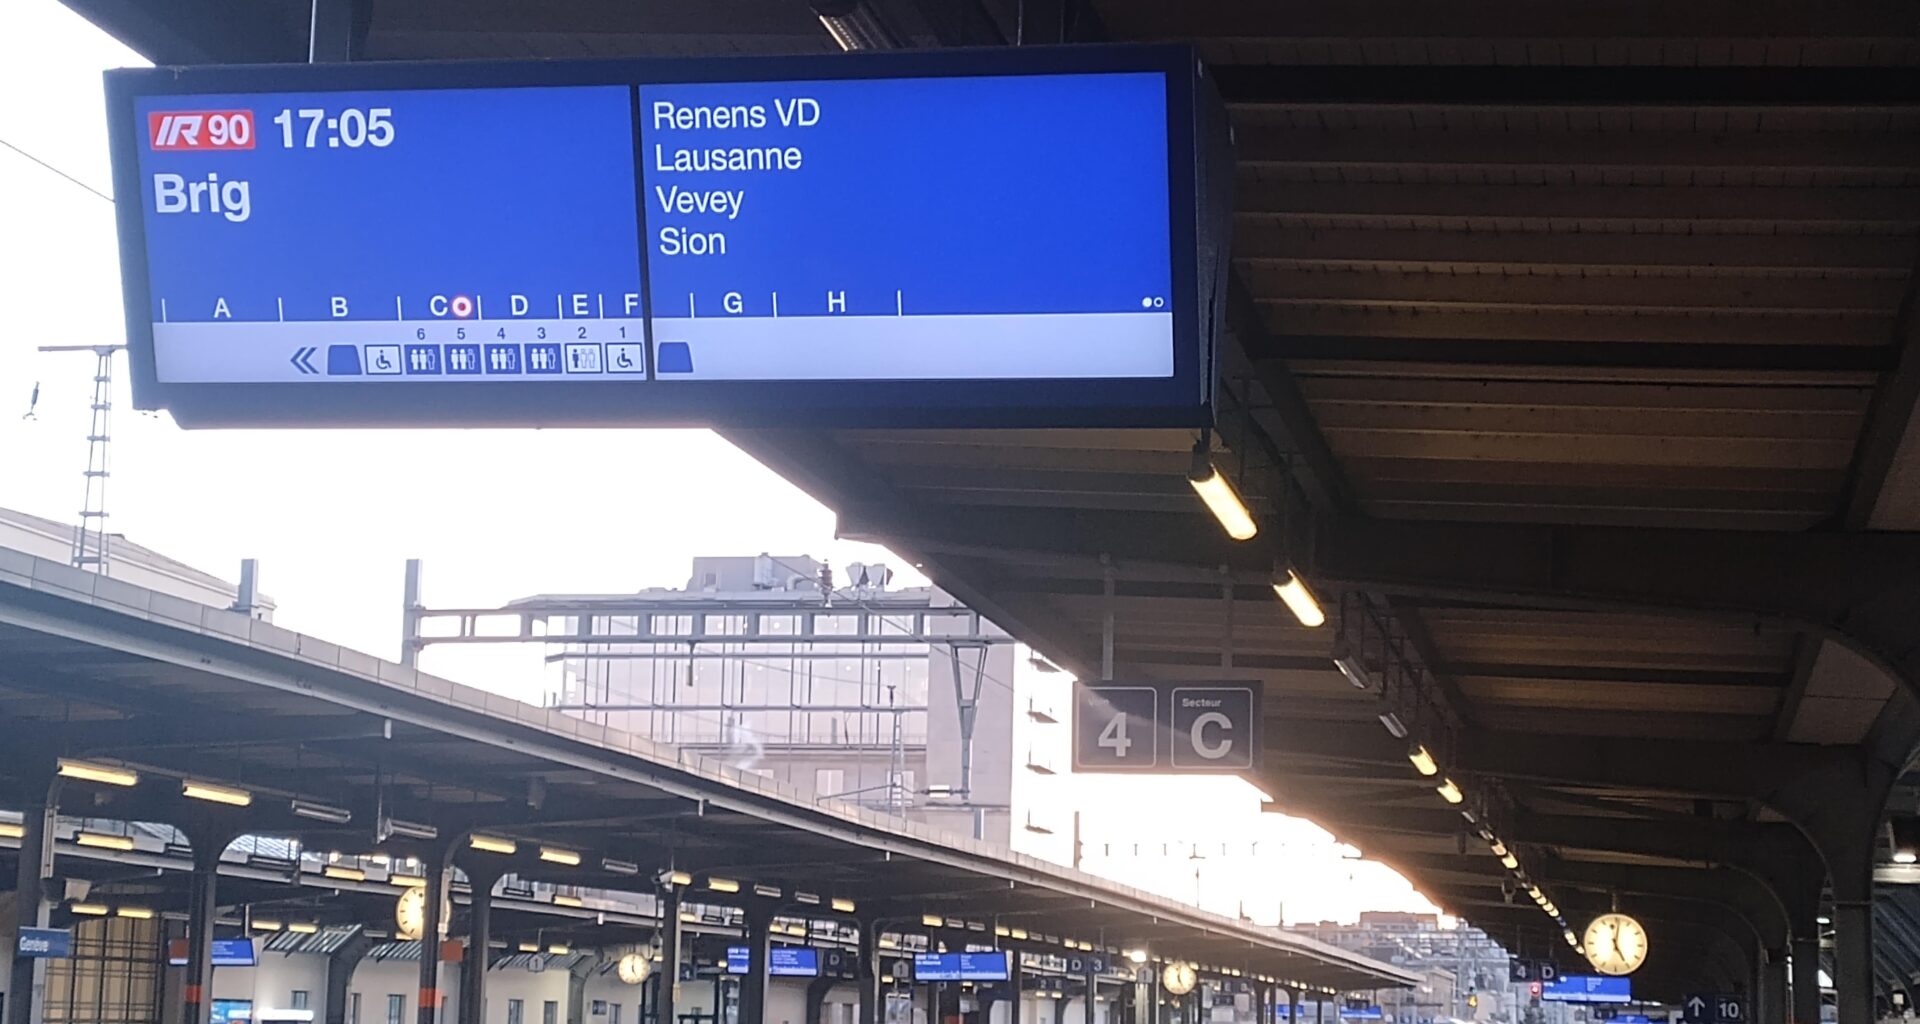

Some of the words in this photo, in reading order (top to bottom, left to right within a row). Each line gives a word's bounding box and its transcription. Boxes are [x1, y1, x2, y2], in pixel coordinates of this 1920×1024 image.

[653, 101, 766, 129] Renens
[775, 98, 820, 126] VD
[156, 116, 202, 146] IR
[208, 114, 250, 146] 90
[273, 108, 395, 148] 17:05
[655, 143, 802, 171] Lausanne
[153, 173, 251, 222] Brig
[656, 185, 744, 219] Vevey
[659, 226, 726, 255] Sion
[213, 297, 231, 318] A
[331, 297, 349, 317] B
[429, 296, 448, 317] C
[510, 295, 529, 316] D
[573, 294, 588, 315] E
[624, 293, 639, 314] F
[723, 292, 743, 314] G
[828, 290, 846, 313] H
[416, 327, 426, 340] 6
[456, 327, 466, 340] 5
[496, 327, 506, 340] 4
[537, 327, 547, 340] 3
[577, 327, 587, 340] 2
[619, 326, 626, 339] 1
[1181, 697, 1222, 708] Secteur
[1098, 712, 1132, 757] 4
[1190, 712, 1233, 759] C
[829, 953, 840, 966] D
[1071, 959, 1082, 971] D
[1093, 959, 1103, 972] 3
[1516, 965, 1526, 979] 4
[1542, 965, 1554, 979] D
[1719, 1002, 1740, 1018] 10
